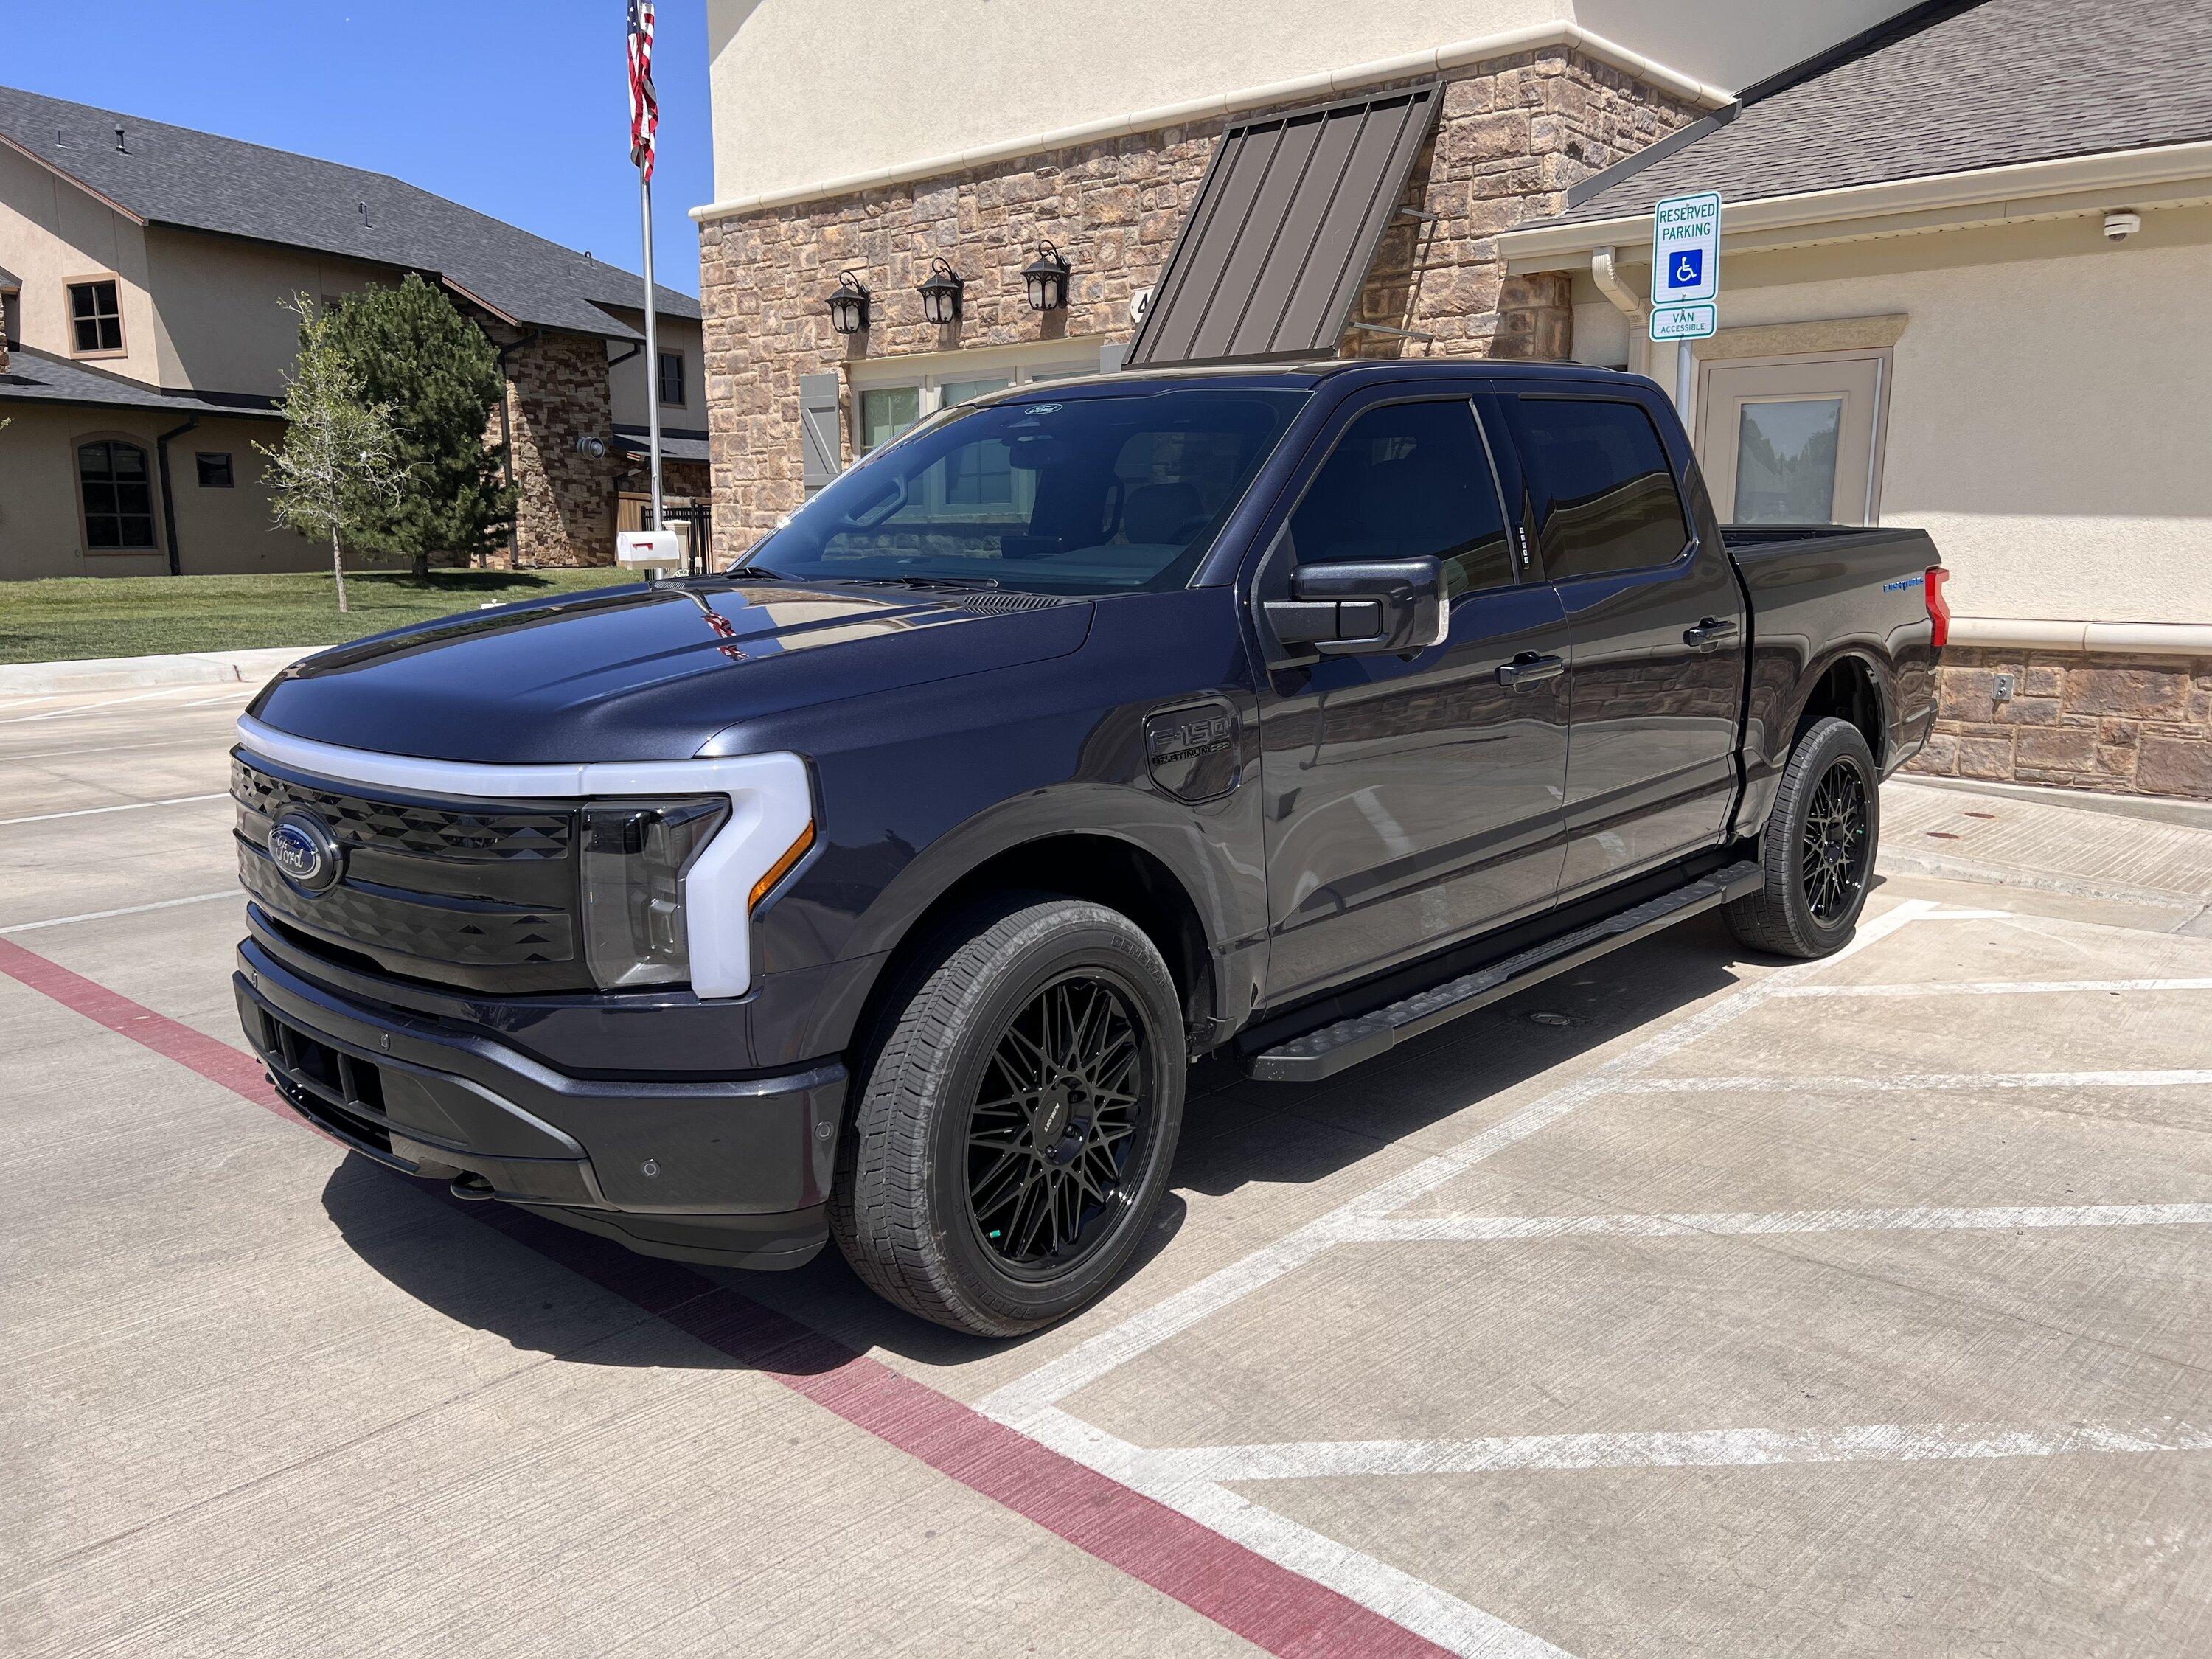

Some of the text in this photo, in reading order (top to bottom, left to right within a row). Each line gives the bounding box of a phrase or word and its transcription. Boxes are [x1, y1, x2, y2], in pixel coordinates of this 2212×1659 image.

[1660, 204, 1715, 223] RESERVED
[1663, 223, 1711, 241] PARKING
[1673, 313, 1694, 323] VAN
[1660, 323, 1705, 333] ACCESSIBLE
[1150, 715, 1230, 755] F-150
[1158, 747, 1211, 765] PLATINUM
[274, 835, 305, 869] Ford
